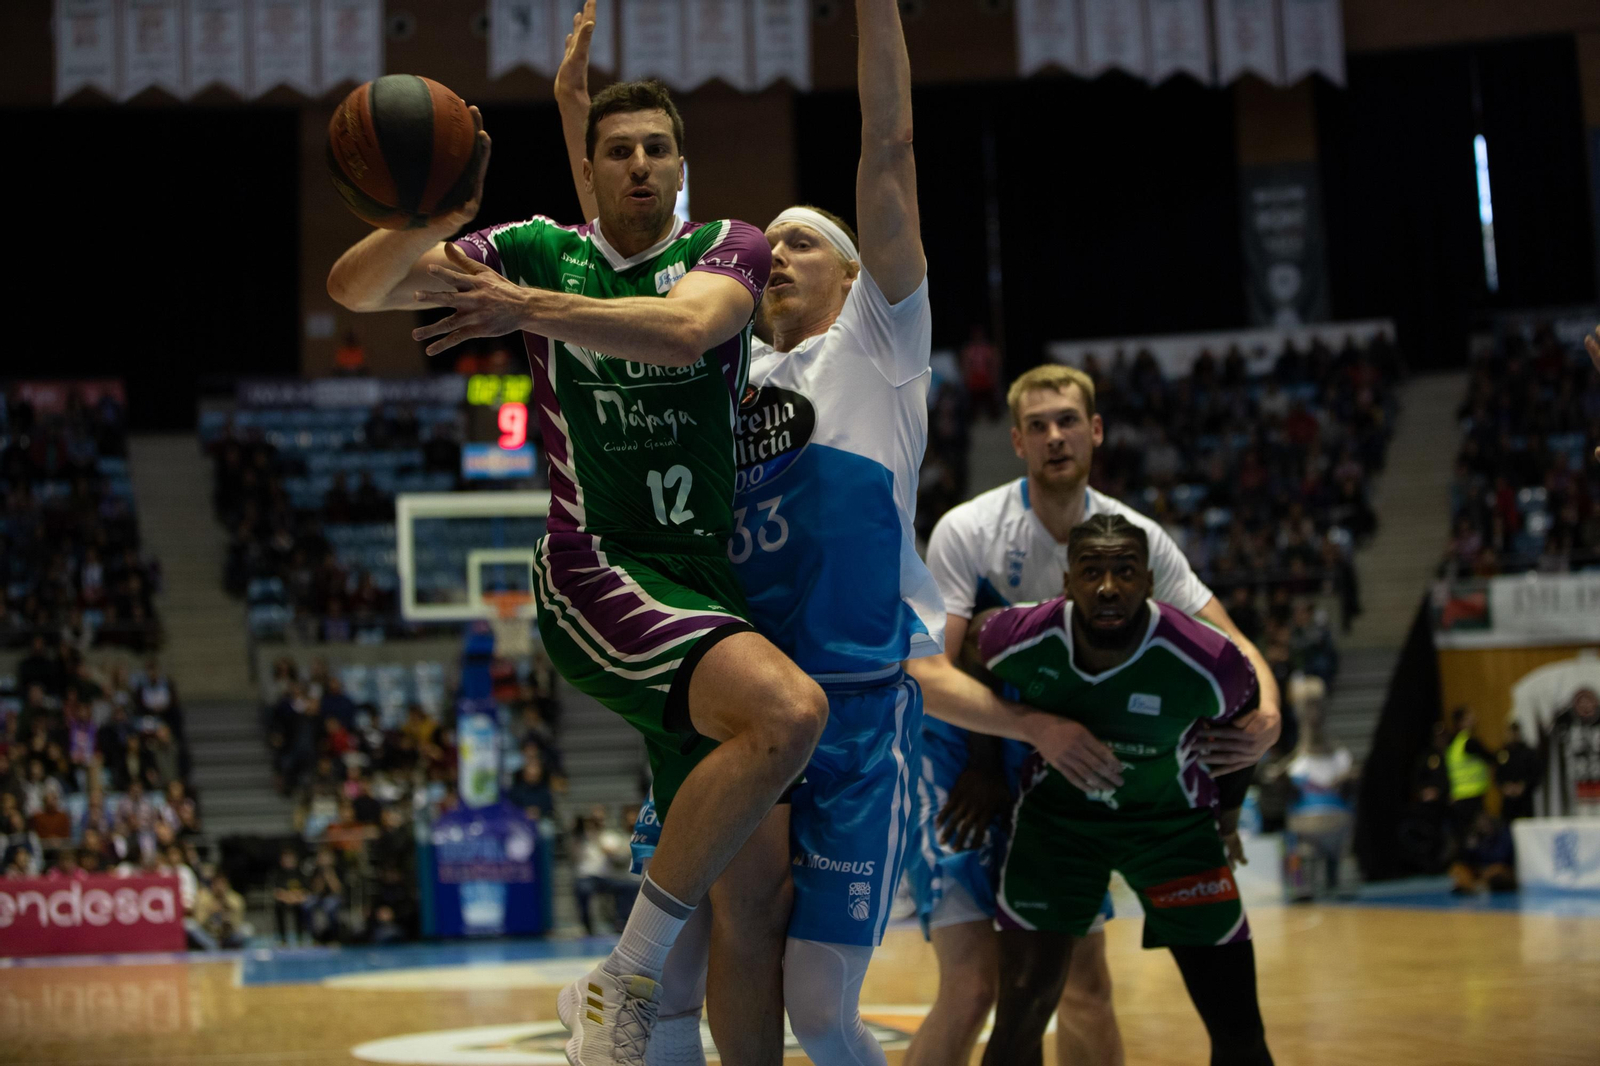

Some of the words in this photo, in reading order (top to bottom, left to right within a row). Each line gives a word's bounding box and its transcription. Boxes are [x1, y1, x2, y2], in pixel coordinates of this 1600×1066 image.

[498, 402, 528, 450] 9
[736, 402, 796, 436] rella
[603, 440, 639, 452] Ciudad
[644, 438, 681, 451] Genial
[736, 430, 793, 465] licia
[646, 464, 695, 526] 12
[727, 495, 789, 564] 33
